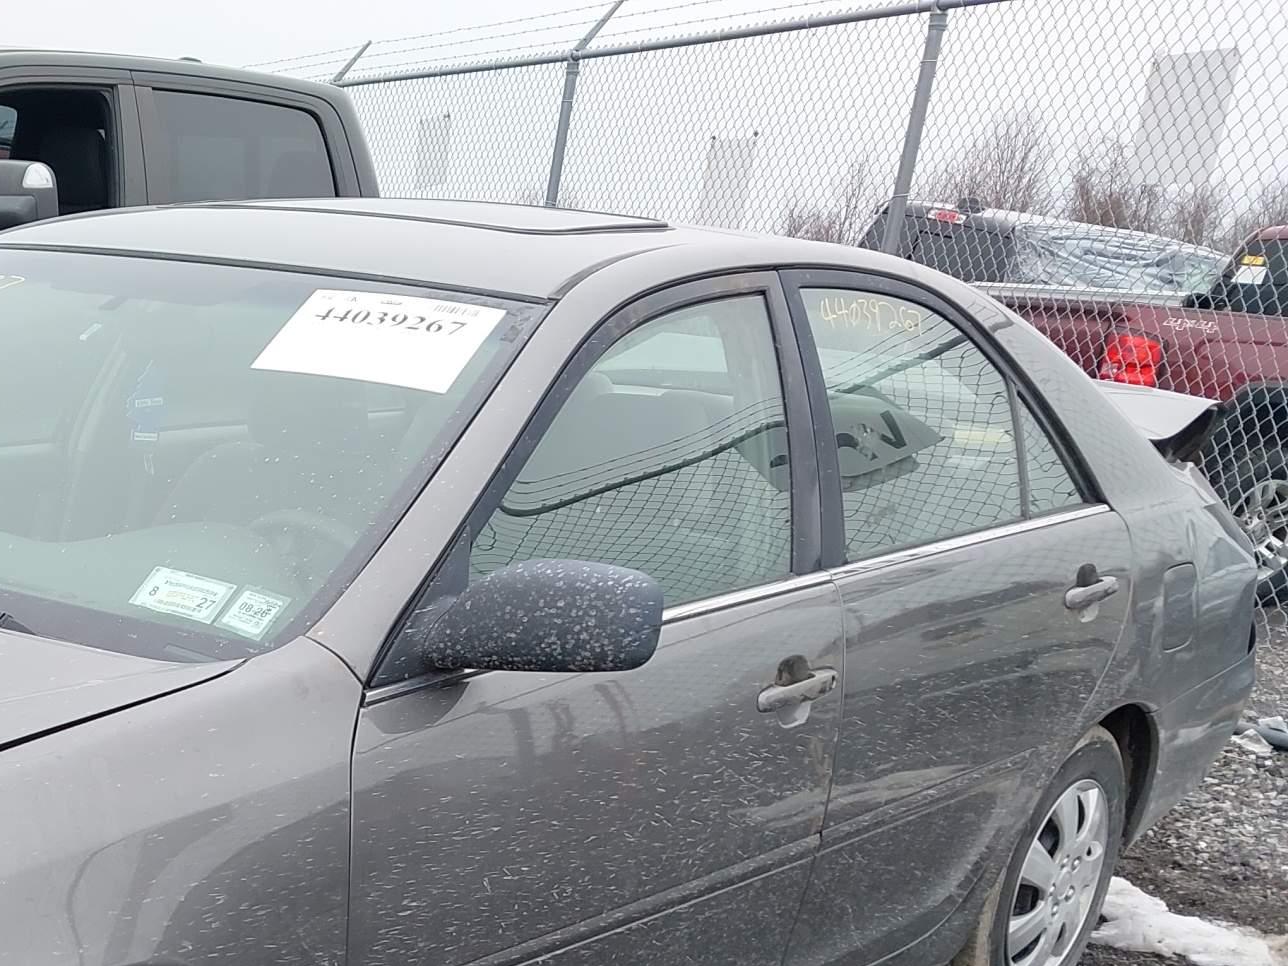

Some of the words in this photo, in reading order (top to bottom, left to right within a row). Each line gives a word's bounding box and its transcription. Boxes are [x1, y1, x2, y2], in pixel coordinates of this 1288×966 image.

[315, 307, 467, 335] 44039267
[820, 297, 922, 336] 44039267
[148, 585, 160, 597] 8
[195, 597, 217, 610] 27
